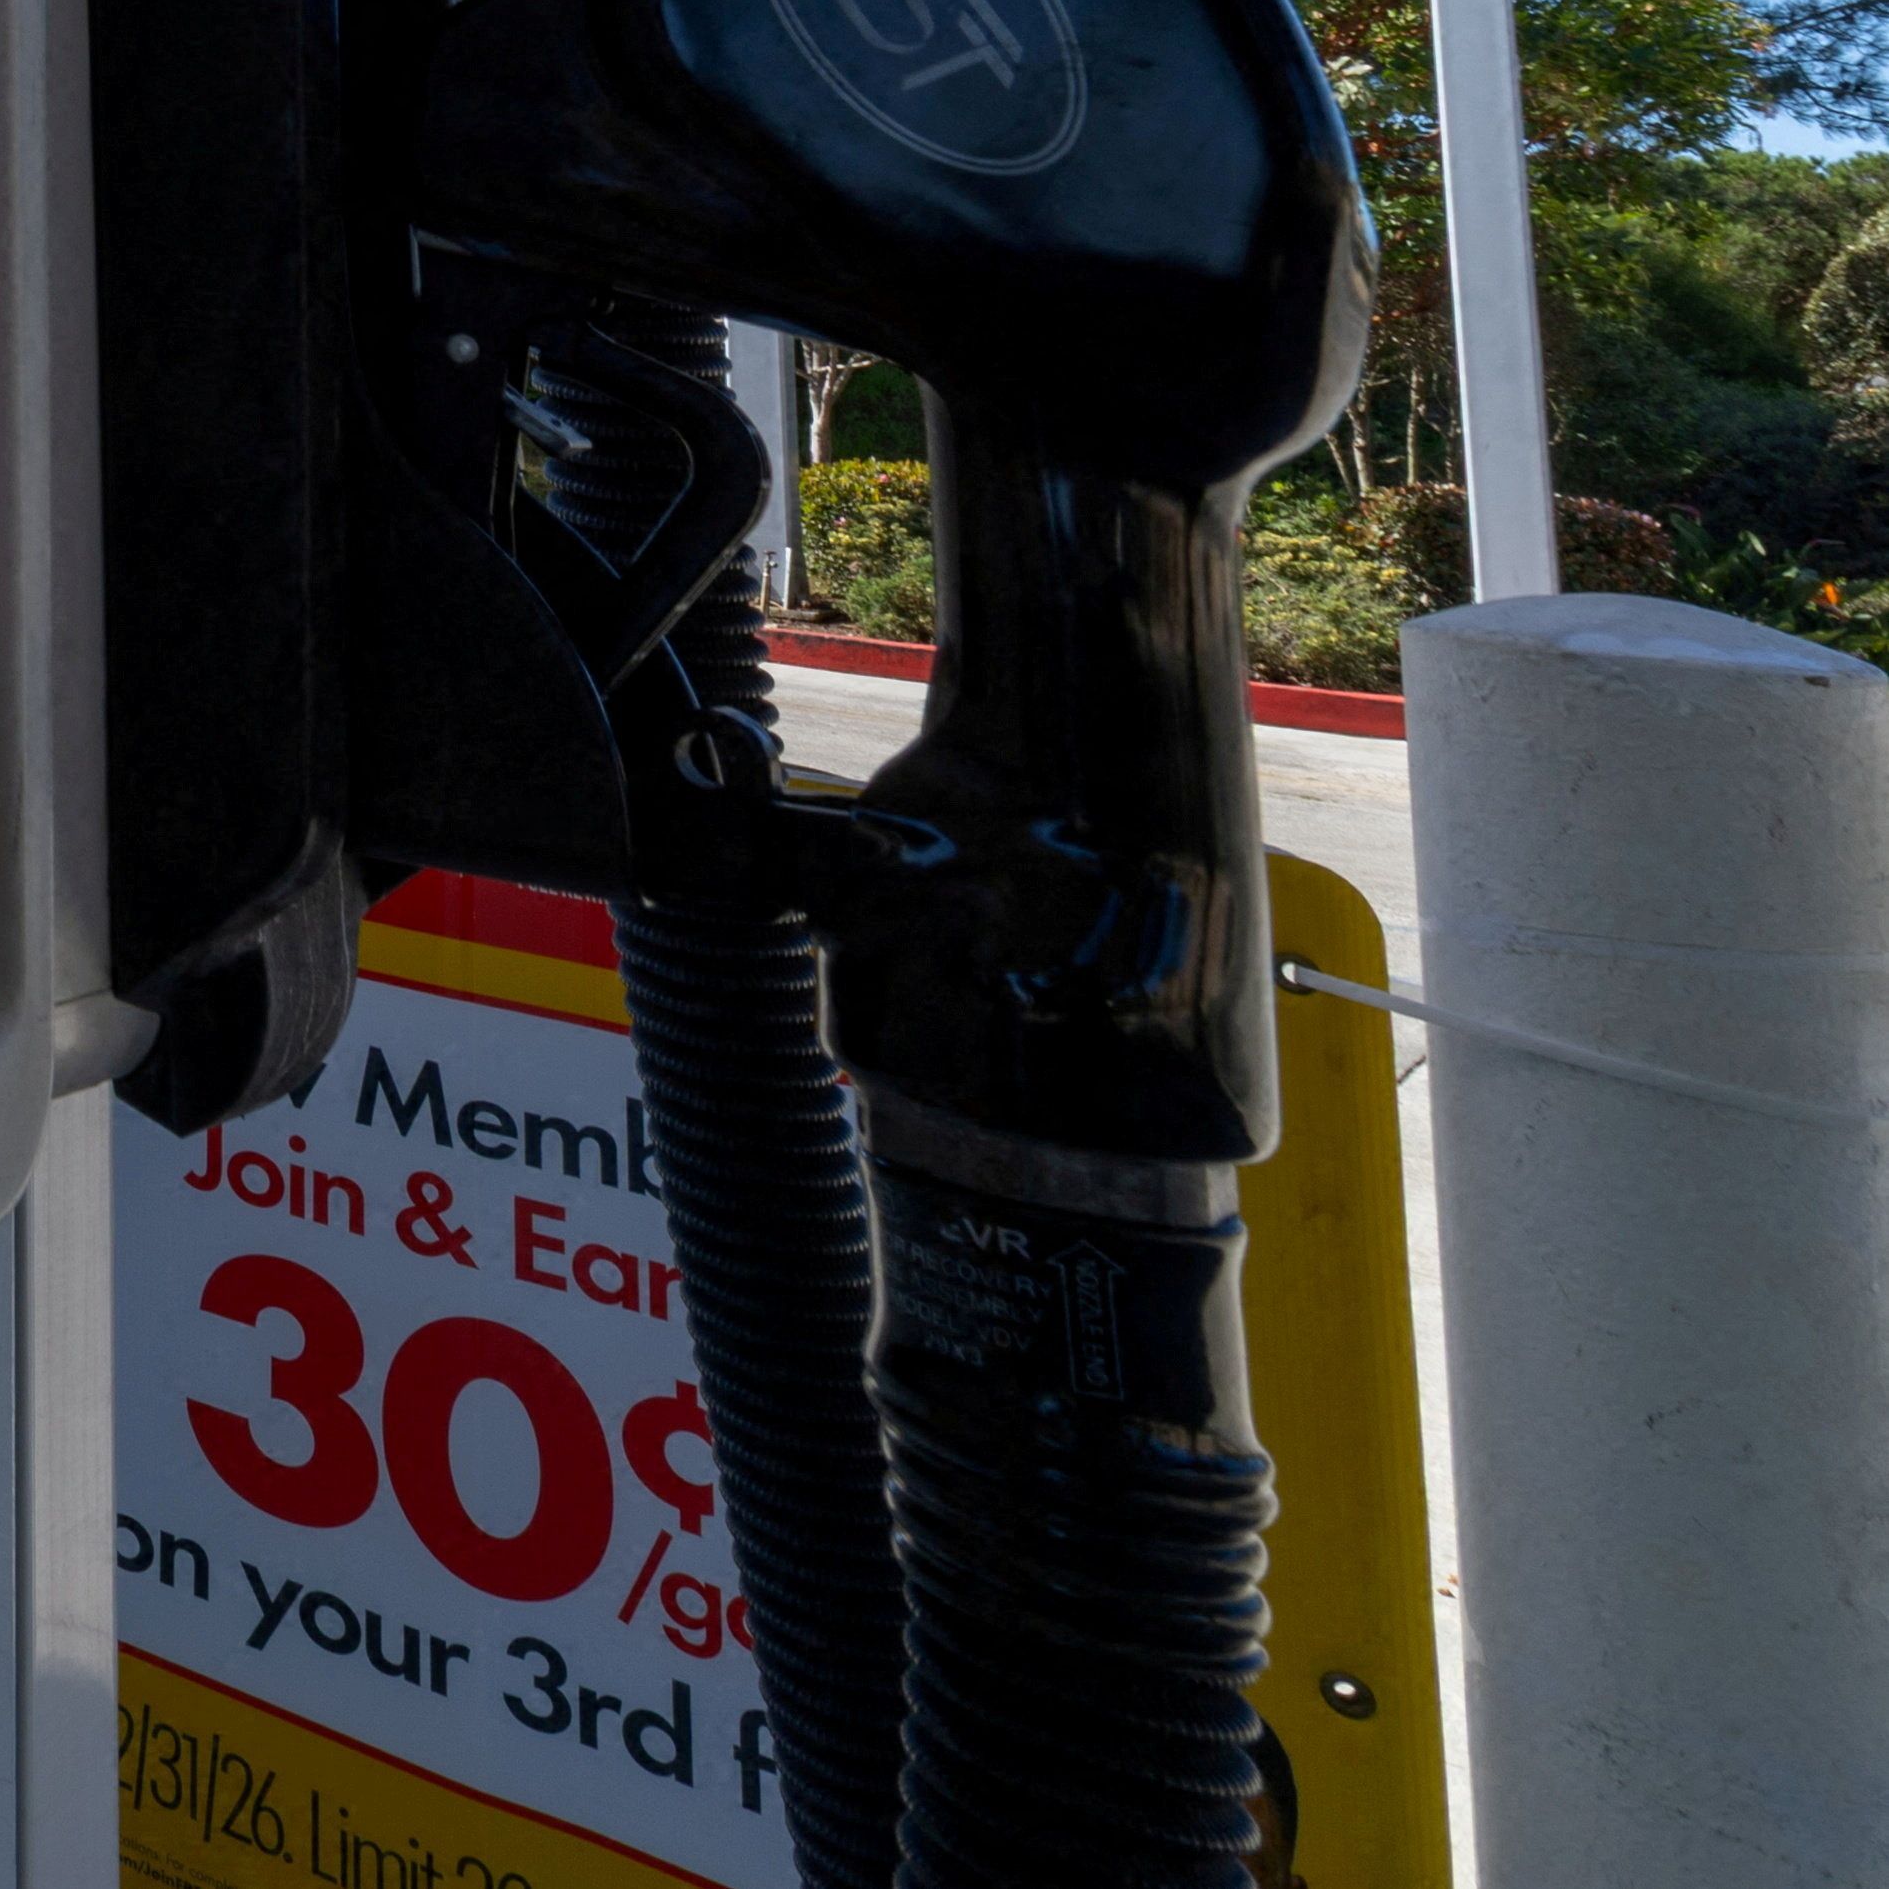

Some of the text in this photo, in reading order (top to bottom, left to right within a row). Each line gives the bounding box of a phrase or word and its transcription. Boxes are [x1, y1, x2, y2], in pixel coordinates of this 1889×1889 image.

[182, 1123, 367, 1239] Join
[394, 1168, 482, 1273] &
[240, 1561, 472, 1699] your
[501, 1634, 697, 1791] 3rd
